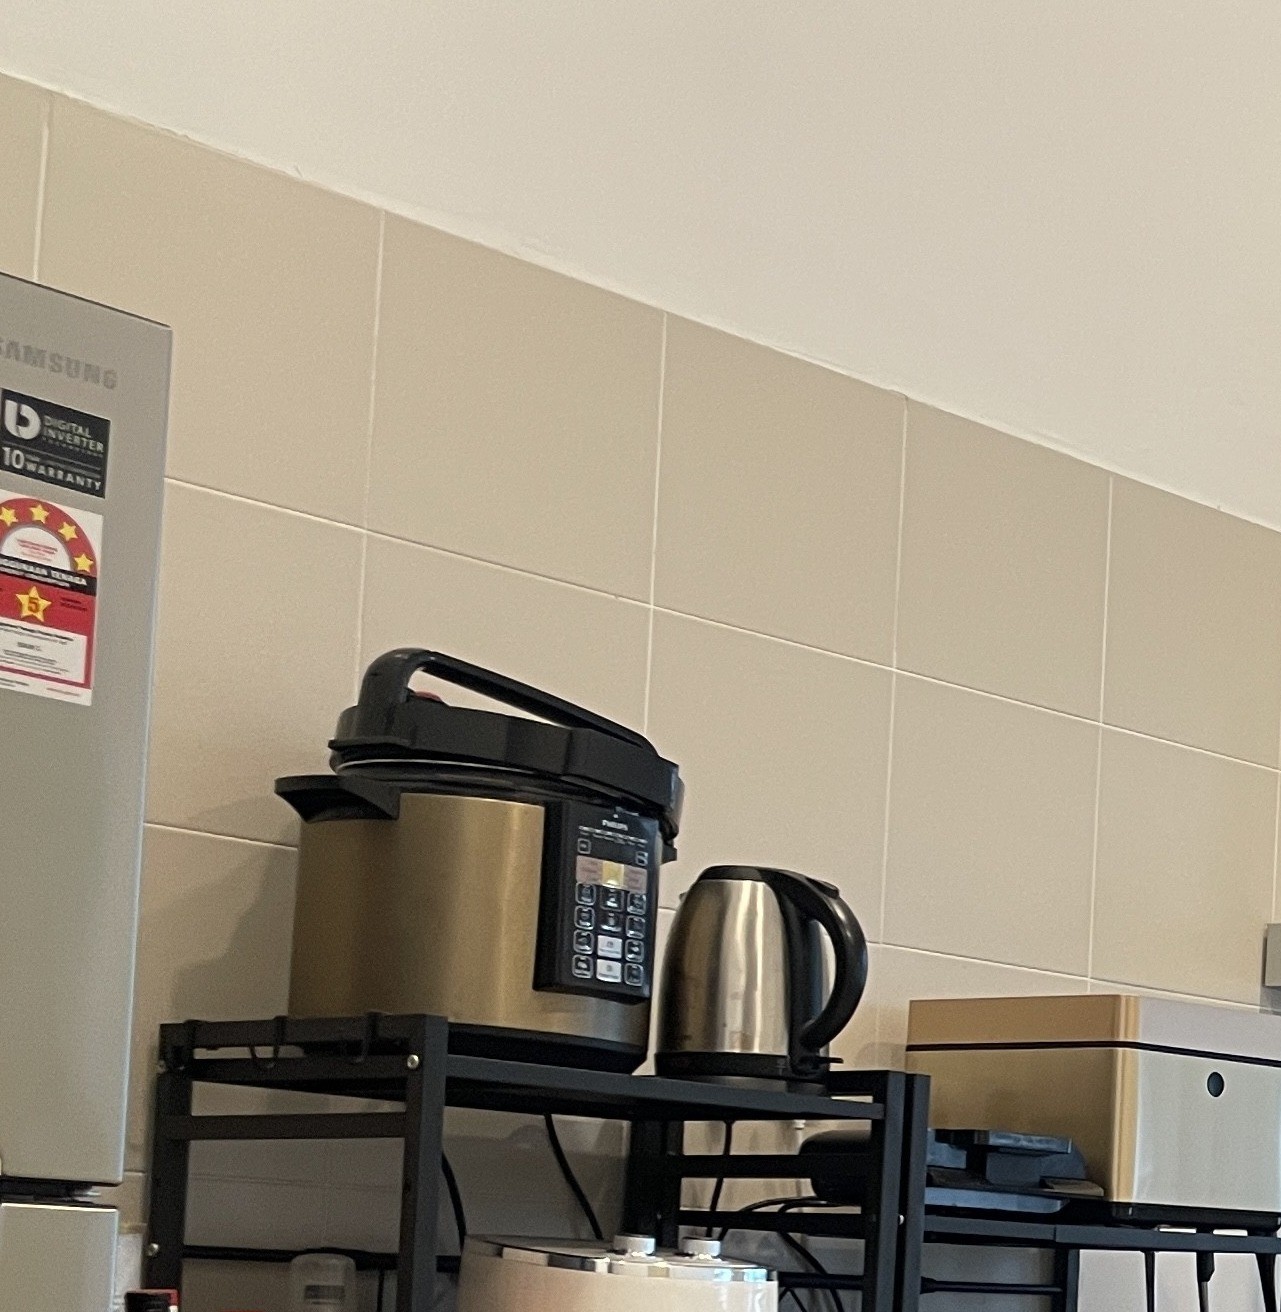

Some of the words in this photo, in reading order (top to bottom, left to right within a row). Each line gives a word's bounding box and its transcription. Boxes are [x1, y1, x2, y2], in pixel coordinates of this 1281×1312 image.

[0, 339, 118, 390] AMSUNG
[43, 414, 92, 439] DIGITAL
[43, 426, 105, 454] INVERTER
[2, 446, 25, 470] 10
[26, 461, 102, 491] WARRANTY
